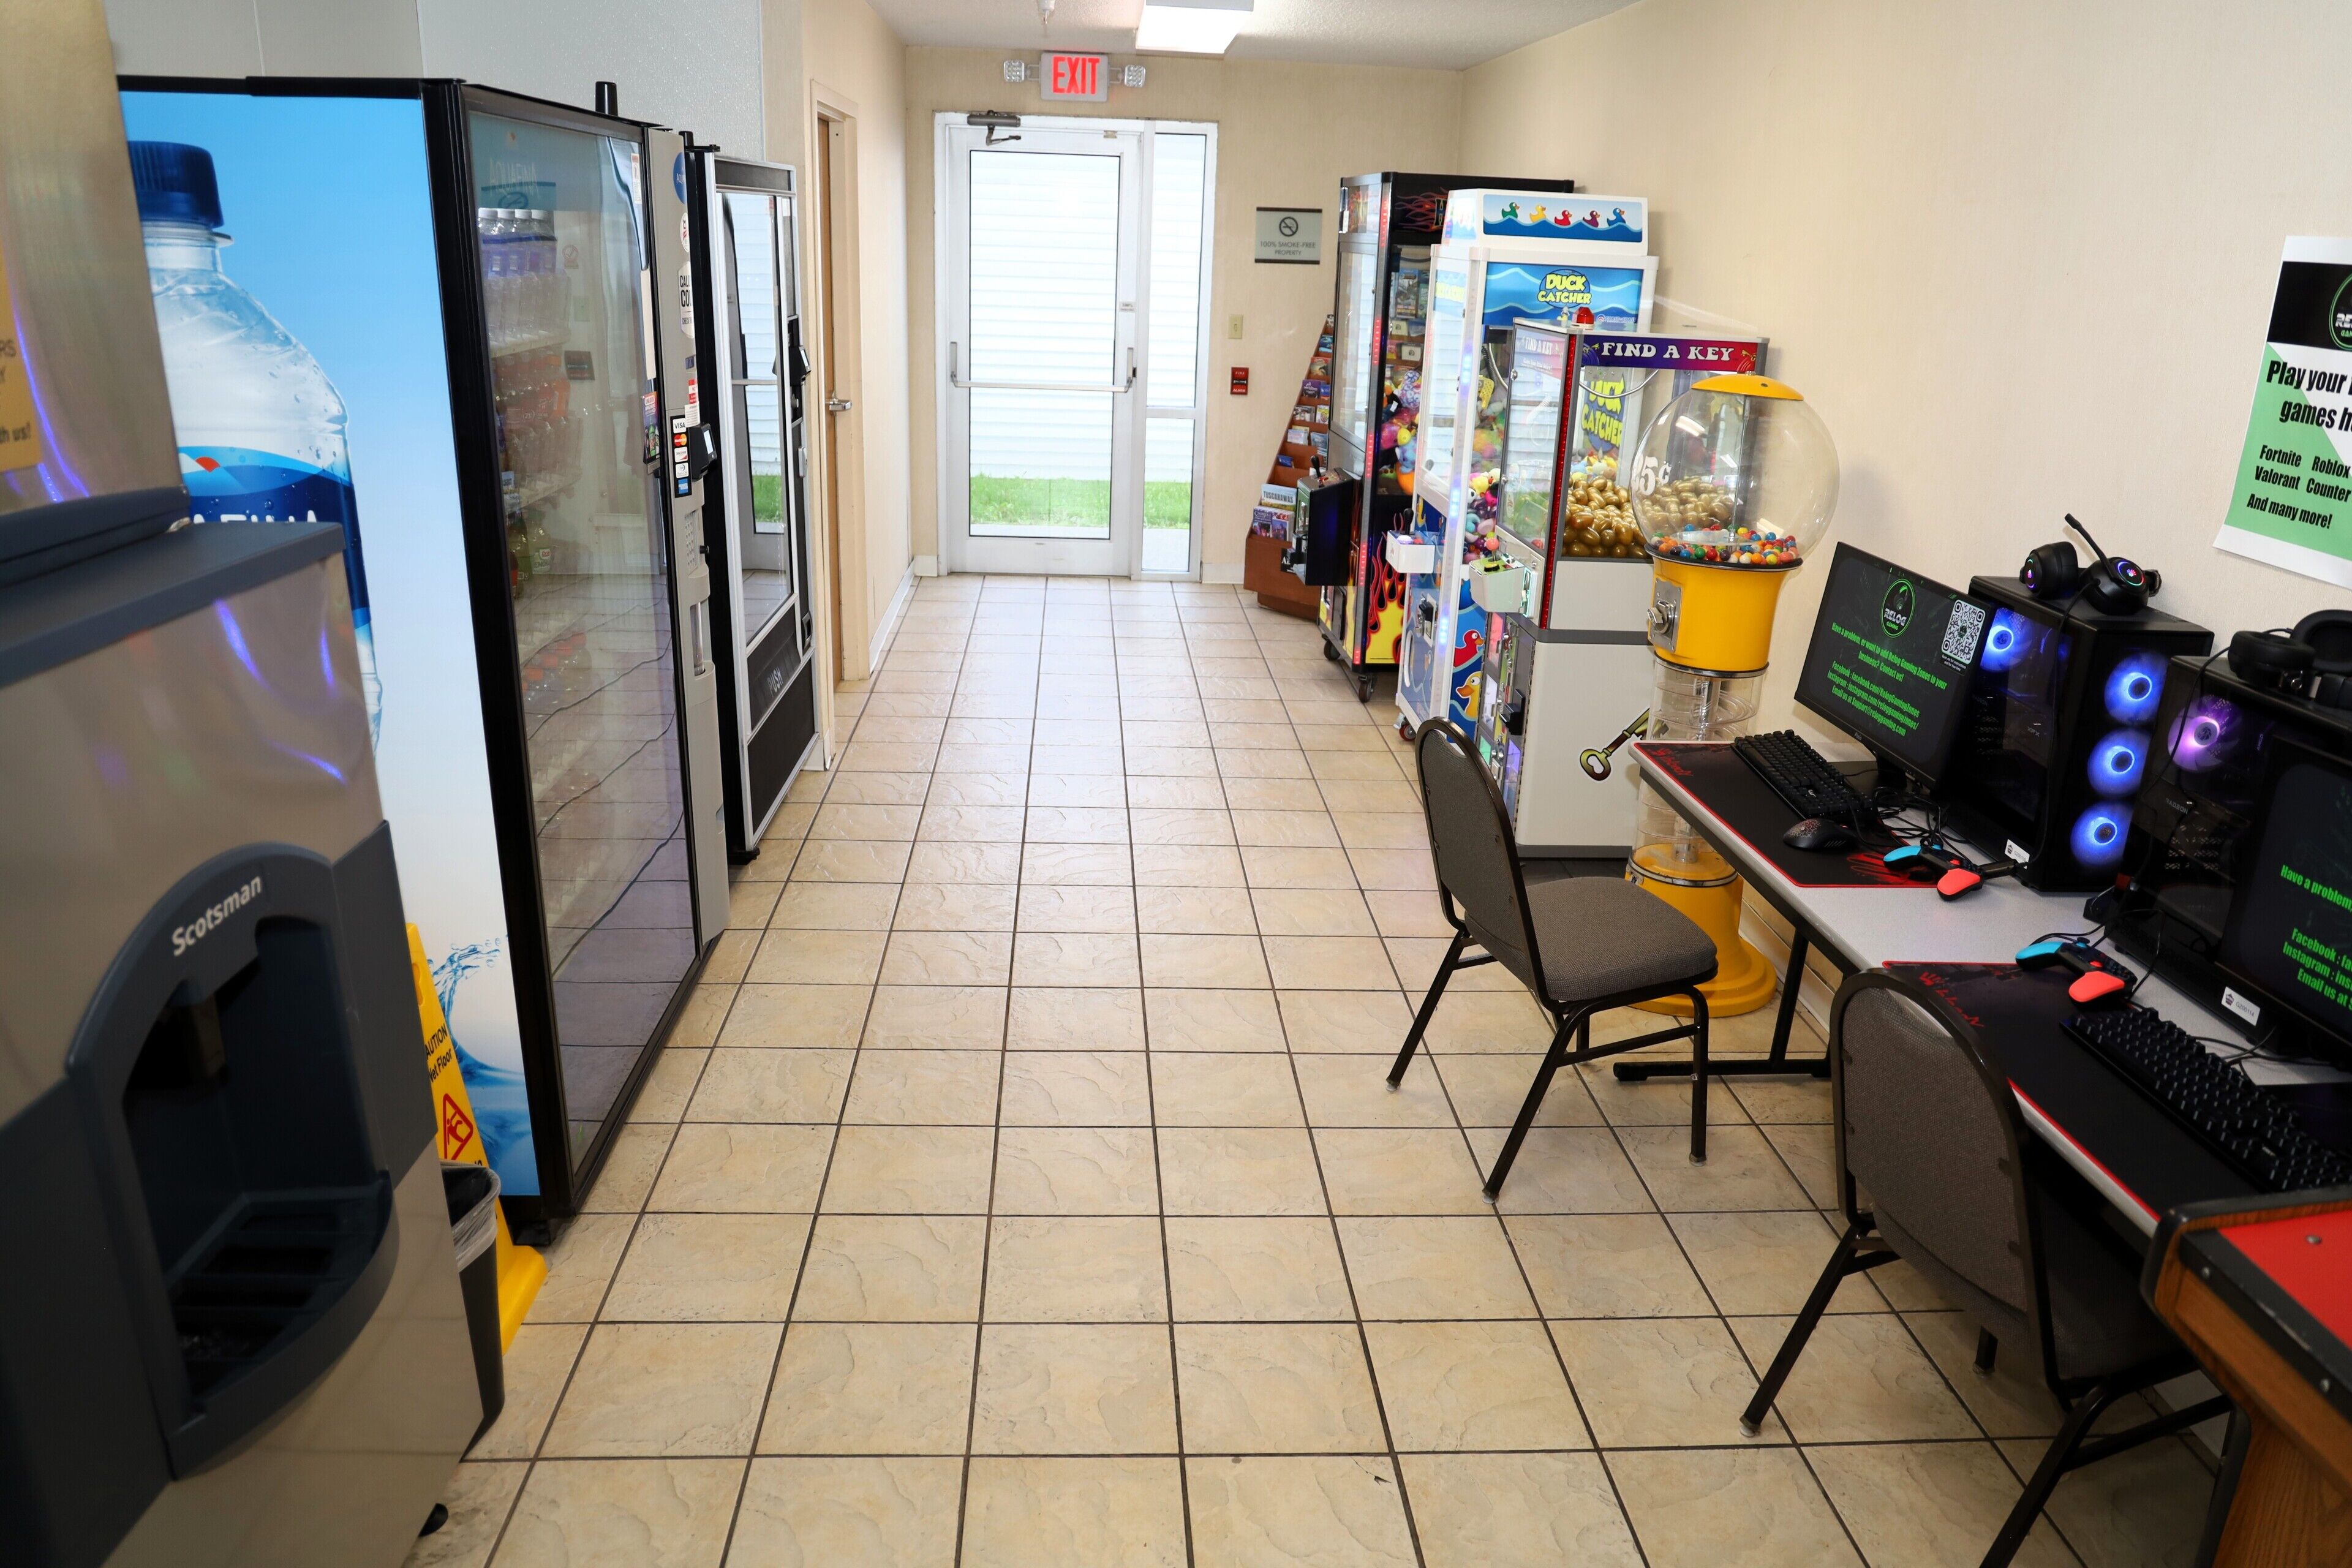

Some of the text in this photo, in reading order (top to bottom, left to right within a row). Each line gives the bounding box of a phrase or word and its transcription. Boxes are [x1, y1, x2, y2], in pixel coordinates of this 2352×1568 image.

[1052, 55, 1101, 95] EXIT
[1545, 273, 1587, 292] DUCK
[1537, 290, 1592, 304] CATCHER
[1601, 342, 1735, 361] FIND A KEY
[2266, 360, 2307, 390] Play
[2306, 369, 2348, 394] your
[2279, 401, 2337, 429] games
[2260, 445, 2351, 478] Fortnite Roblox
[1264, 491, 1294, 503] TUSCARAWAS
[2255, 466, 2352, 502] Valorant Counter
[2247, 493, 2333, 529] And many more!
[1884, 608, 1907, 627] RELOG
[1831, 622, 1842, 633] Have
[1866, 641, 1876, 653] want
[1875, 646, 1881, 655] to
[1880, 648, 1890, 659] add
[1888, 652, 1901, 666] Relog
[1901, 658, 1917, 676] Gaming
[1916, 667, 1931, 682] Zones
[1930, 674, 1936, 684] to
[1934, 677, 1948, 690] your
[1832, 660, 1851, 679] Facebook
[1858, 650, 1905, 682] business? Contact us!
[768, 670, 783, 697] PUSH
[1827, 670, 1847, 688] Instagram
[1831, 685, 1844, 698] Email
[1842, 693, 1848, 701] us
[1847, 695, 1853, 704] at
[2166, 797, 2188, 814] RADEON
[2280, 864, 2304, 886] Have
[2304, 878, 2311, 890] a
[172, 876, 262, 957] Scotsman
[2292, 928, 2337, 962] Facebook
[2282, 941, 2331, 978] Instagram
[2297, 968, 2324, 992] Email
[2324, 985, 2336, 1000] us
[2337, 993, 2348, 1007] at
[425, 1022, 447, 1060] AUTION
[436, 1049, 452, 1073] Floor
